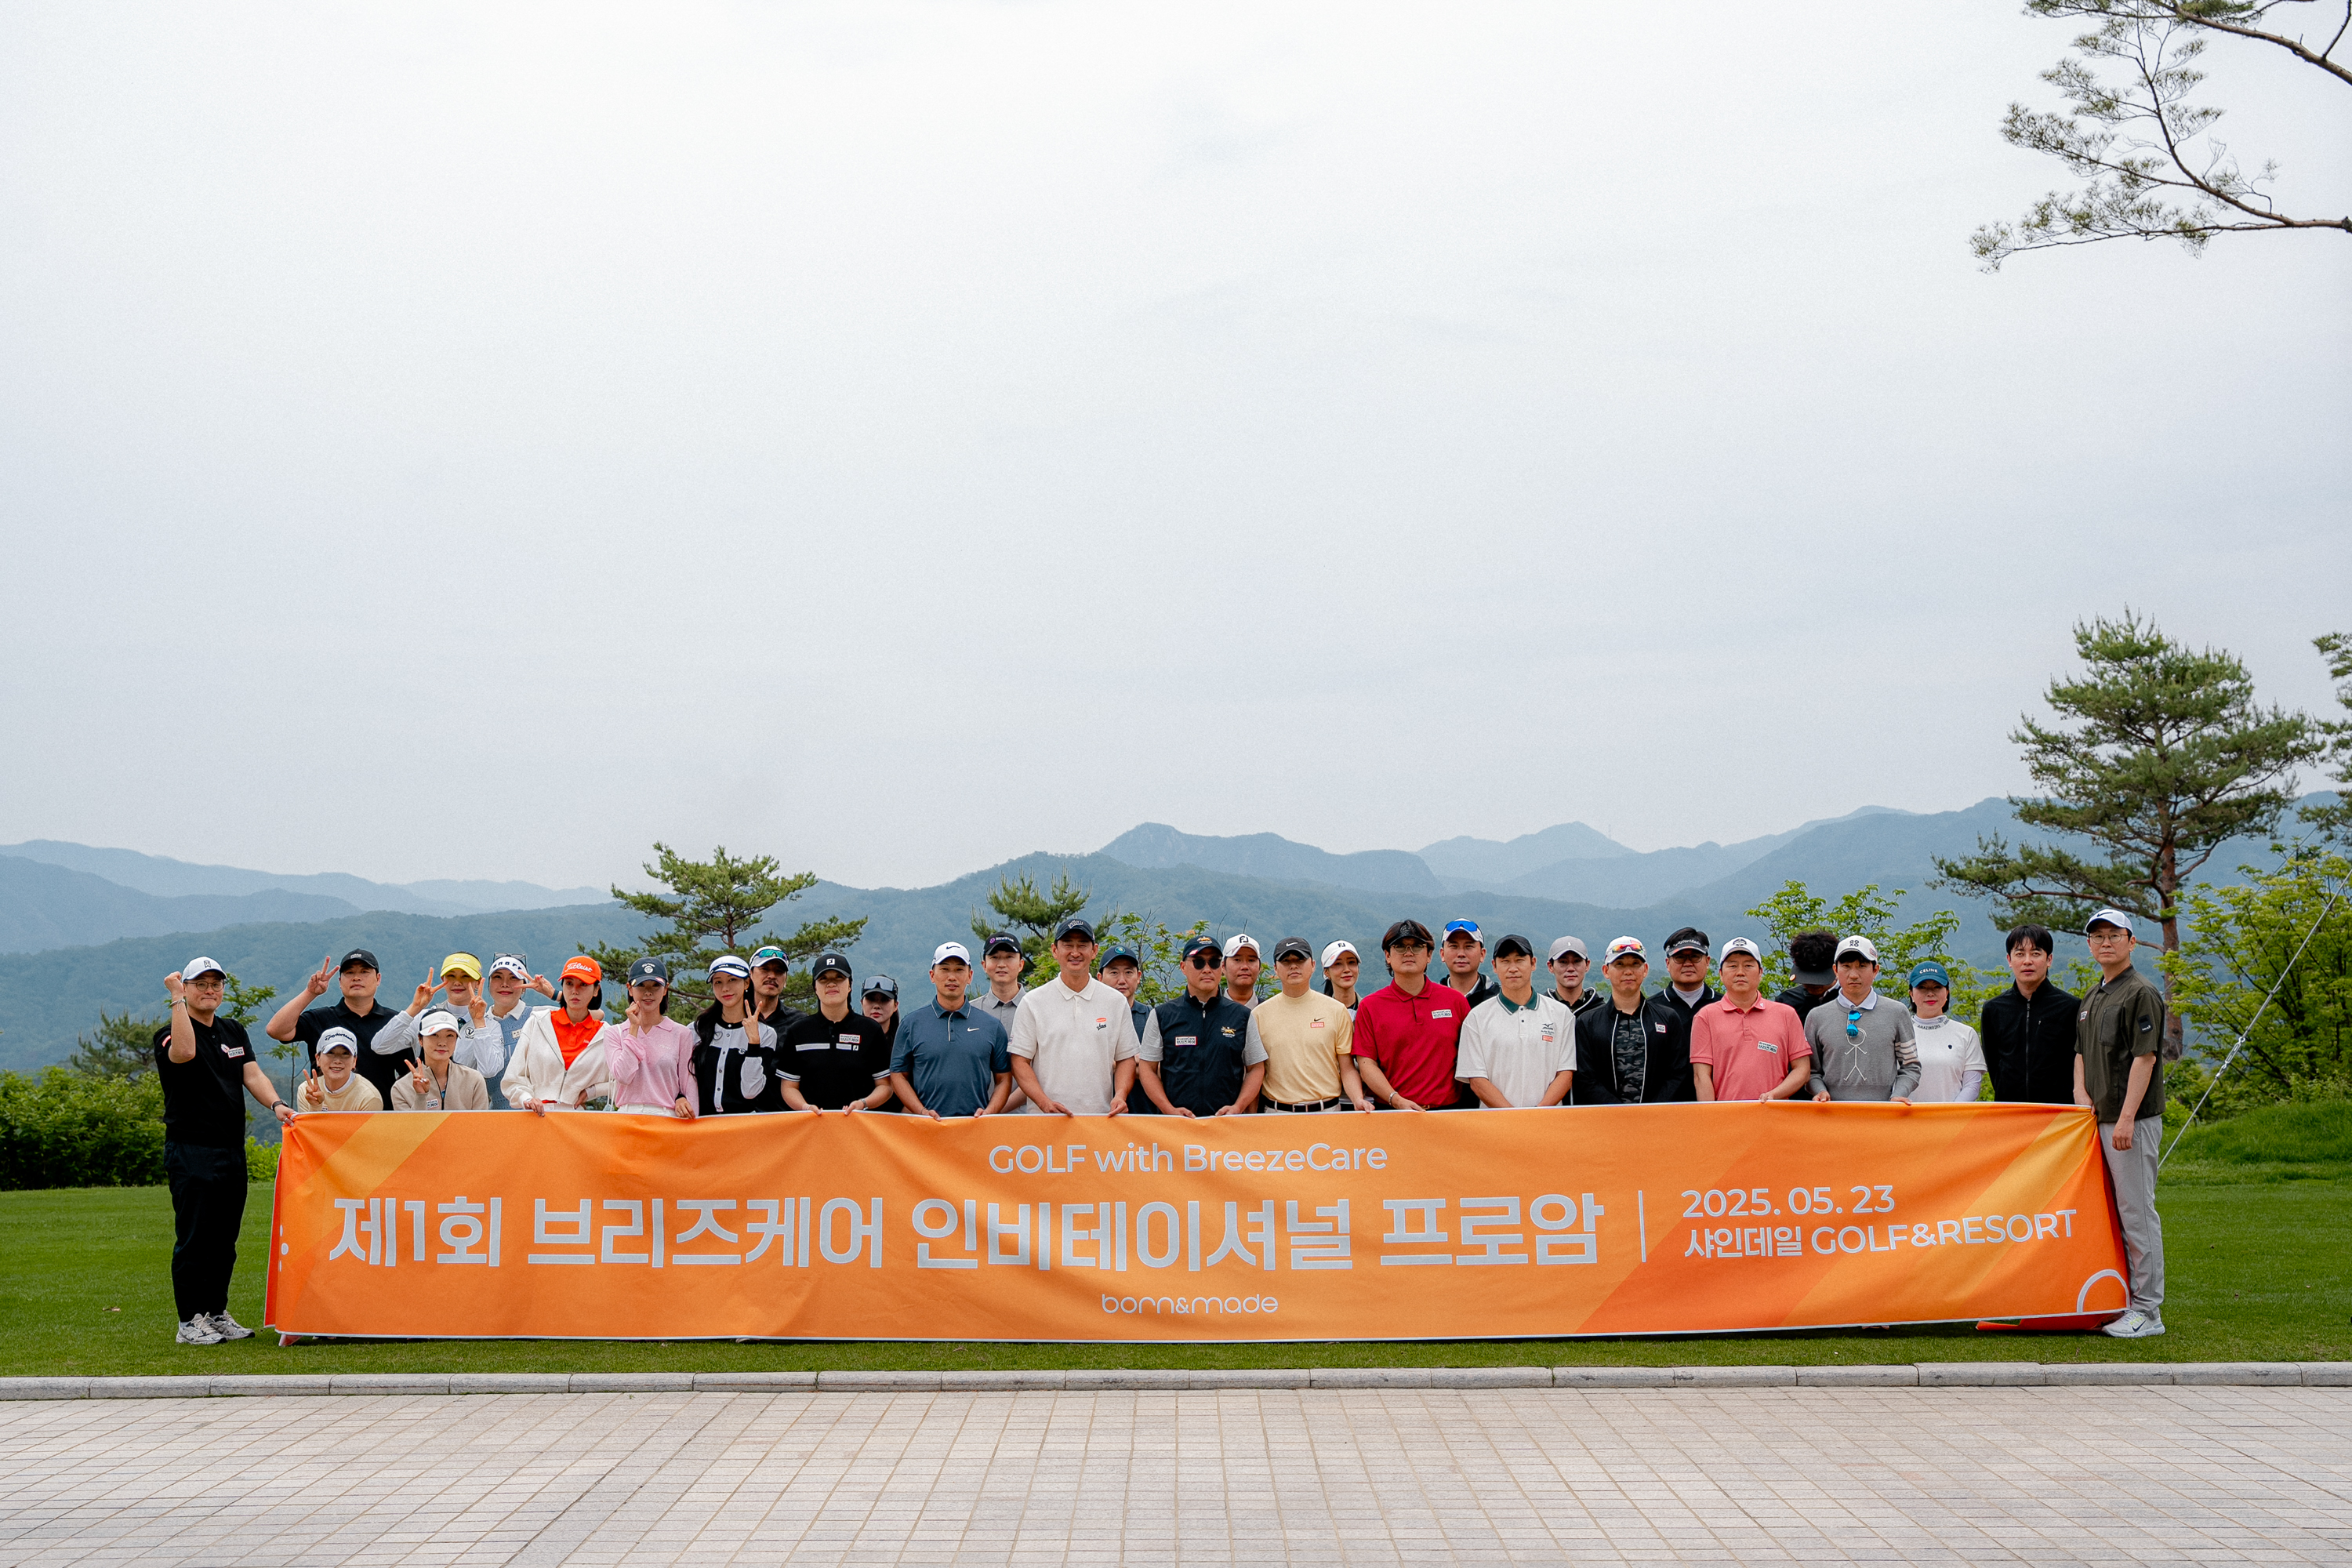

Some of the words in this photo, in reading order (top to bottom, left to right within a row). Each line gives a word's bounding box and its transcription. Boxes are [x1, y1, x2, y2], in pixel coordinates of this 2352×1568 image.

[564, 962, 593, 973] Titleist
[325, 1033, 354, 1043] TaylorMade
[989, 1145, 1087, 1174] GOLF
[1094, 1142, 1174, 1173] with
[1184, 1142, 1388, 1172] BreezeCare
[1681, 1188, 1781, 1218] 2025.
[1788, 1186, 1843, 1215] 05.
[1850, 1185, 1895, 1214] 23
[329, 1196, 503, 1268] 제1회
[528, 1196, 883, 1269] 브리즈케어
[911, 1198, 1353, 1272] 인비테이셔널
[1380, 1192, 1605, 1266] 프로암
[1684, 1225, 1802, 1258] 샤인데일
[1811, 1208, 2077, 1255] GOLF&RESORT
[1102, 1294, 1279, 1315] born&made
